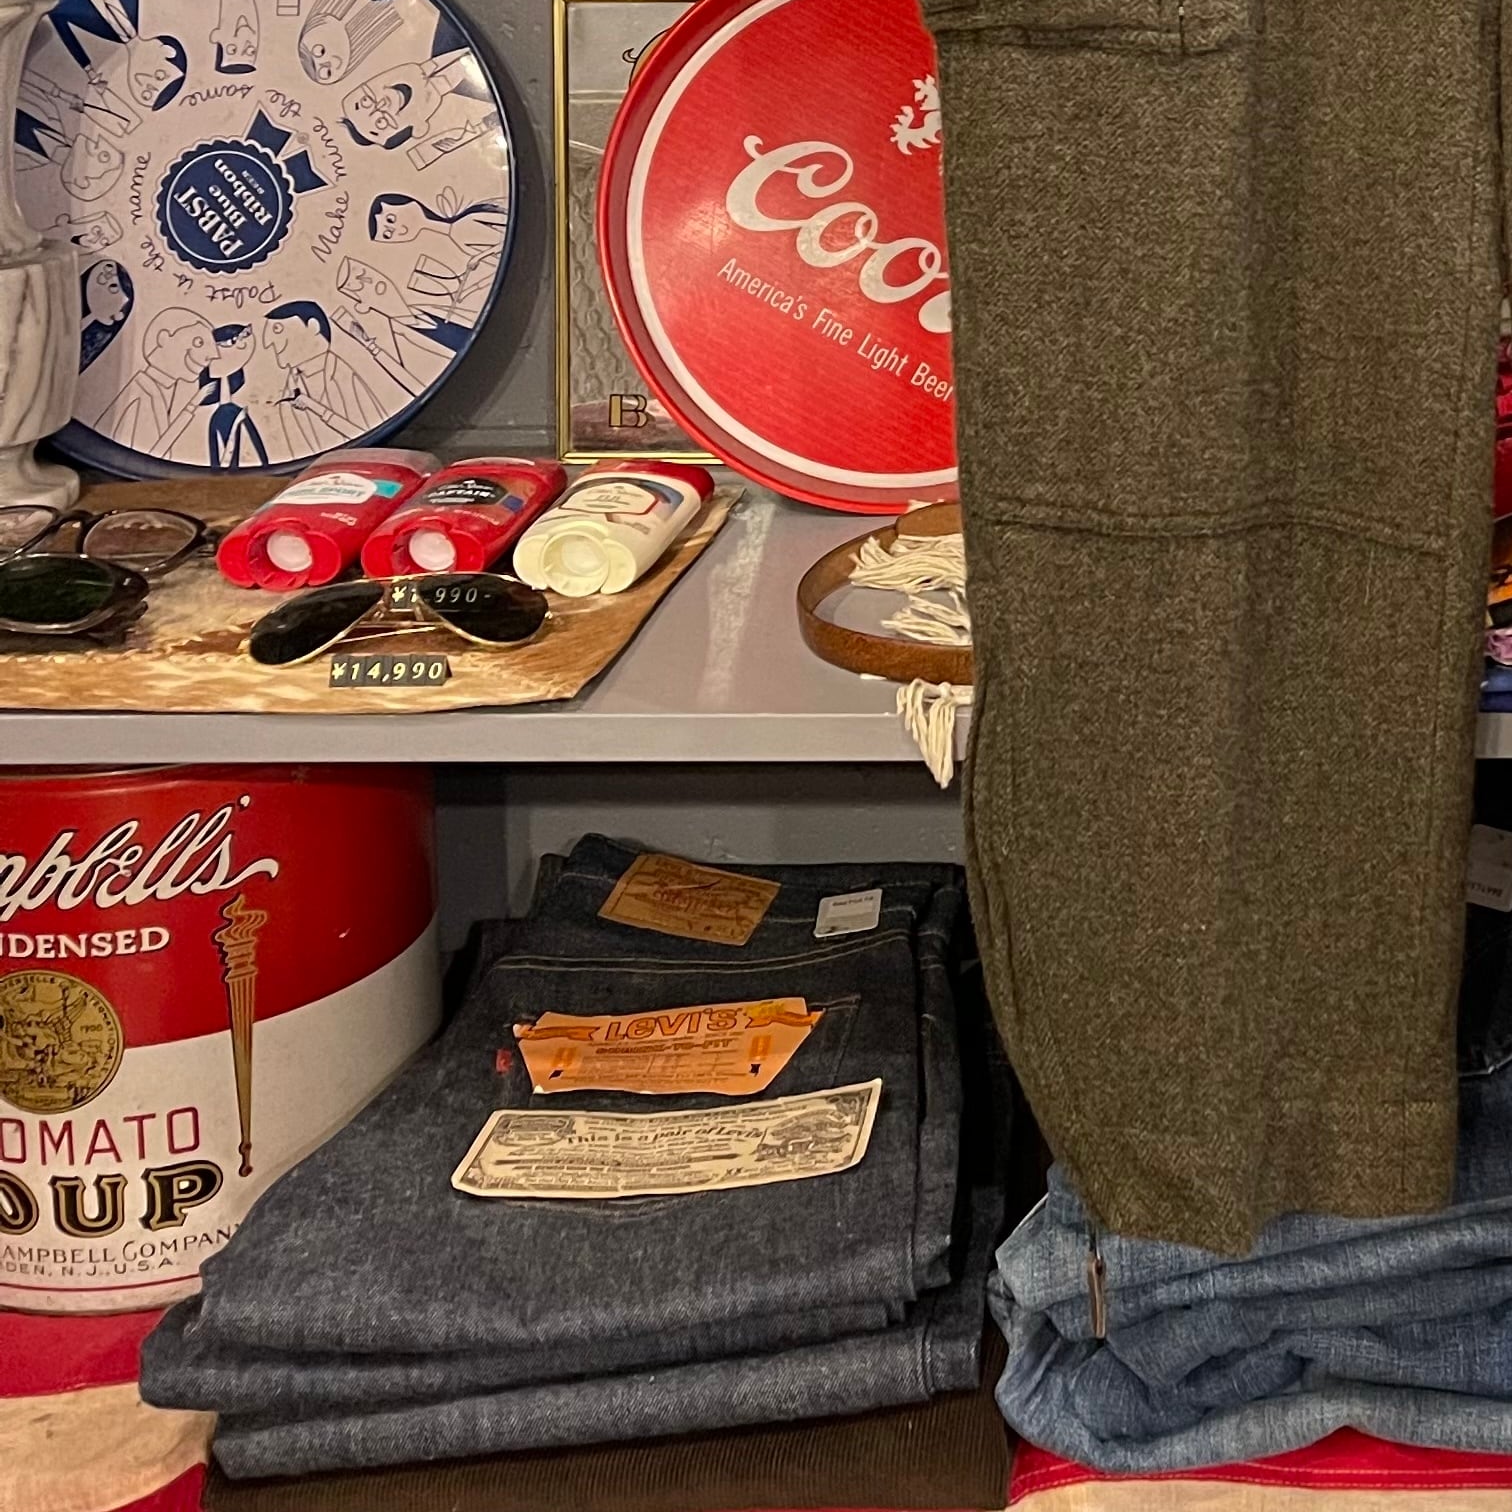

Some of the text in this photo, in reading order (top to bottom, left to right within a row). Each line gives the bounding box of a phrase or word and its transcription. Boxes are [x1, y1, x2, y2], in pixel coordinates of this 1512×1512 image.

[179, 84, 349, 263] Make mine the same
[208, 185, 248, 229] Blue
[214, 159, 273, 226] Ribbon
[130, 152, 282, 309] Pabst is the name
[174, 186, 244, 258] PABST
[717, 257, 953, 402] America's Fine Light Beer
[332, 662, 443, 682] ¥14,990
[122, 1223, 241, 1262] COMPAN
